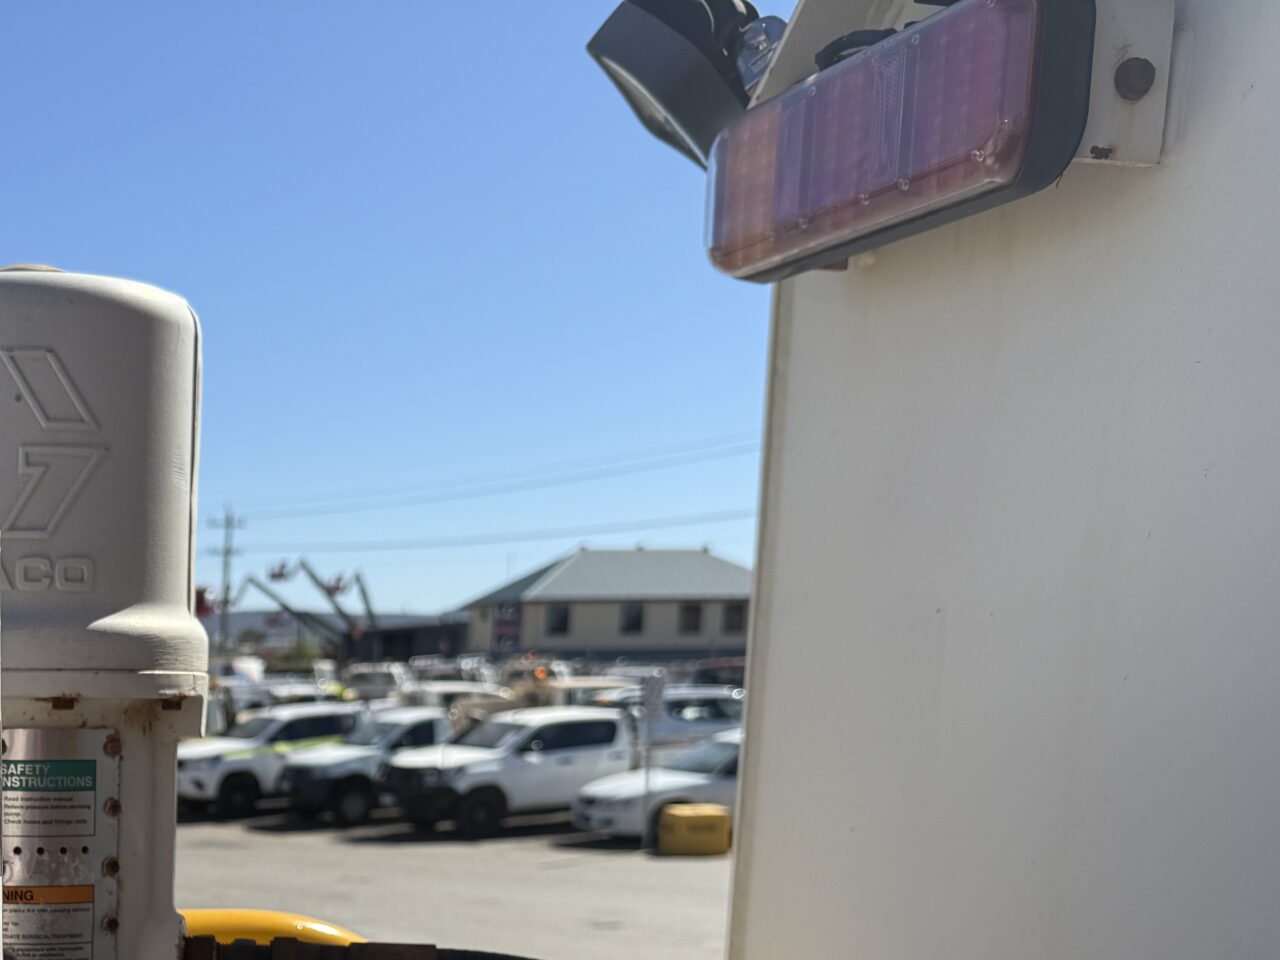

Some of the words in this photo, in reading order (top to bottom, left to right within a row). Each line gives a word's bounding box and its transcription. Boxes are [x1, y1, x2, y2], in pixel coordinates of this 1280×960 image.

[0, 763, 50, 775] SAFETY
[2, 775, 93, 787] NSTRUCTIONS
[3, 890, 34, 901] NING
